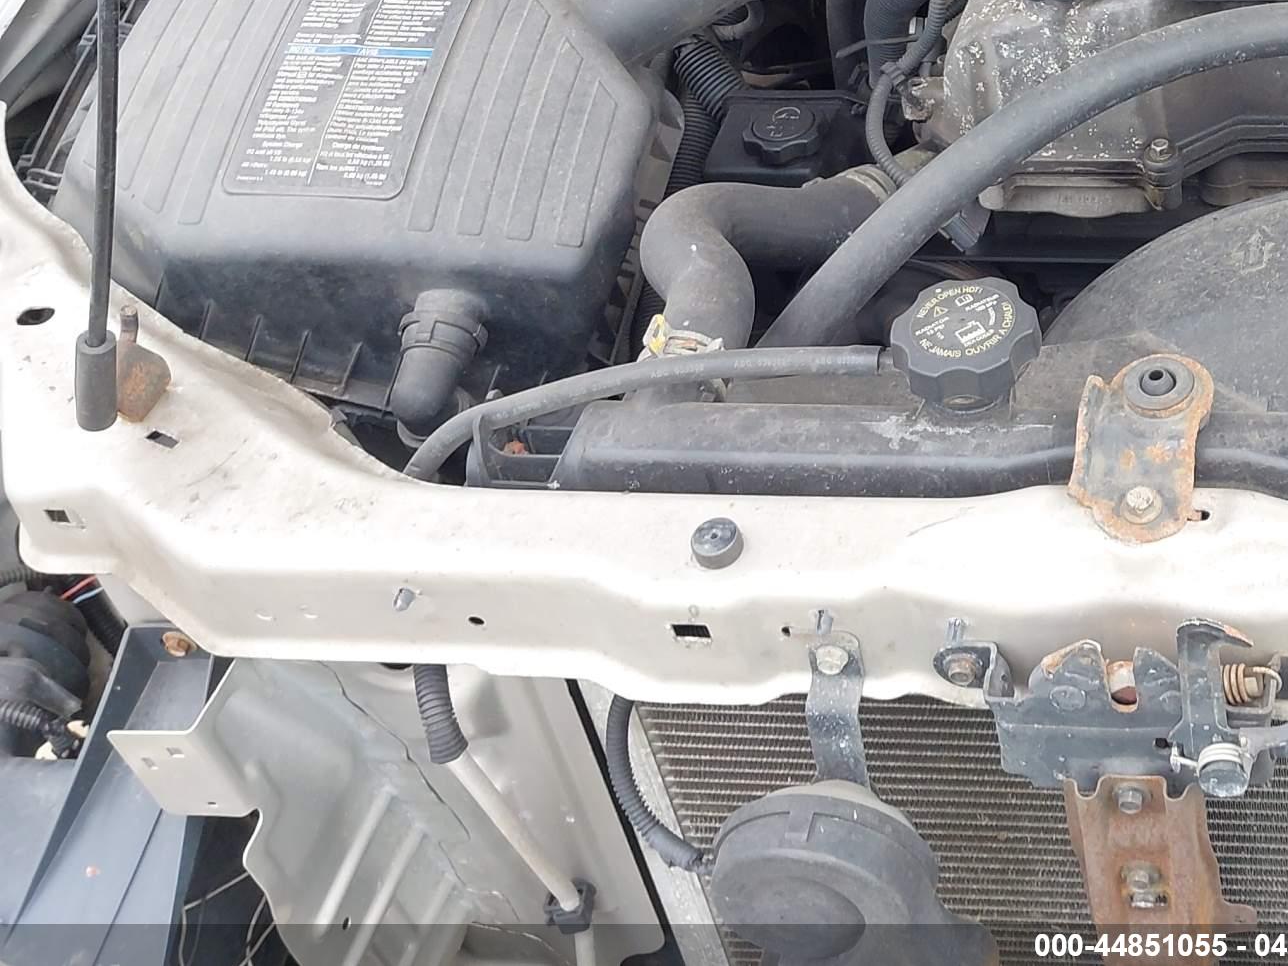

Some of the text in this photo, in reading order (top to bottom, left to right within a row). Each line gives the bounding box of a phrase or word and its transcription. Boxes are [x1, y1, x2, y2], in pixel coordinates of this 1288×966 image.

[916, 298, 939, 318] NEVER
[938, 288, 961, 300] OPEN
[919, 338, 934, 349] NE
[929, 345, 961, 358] JAMAIS
[965, 334, 1003, 356] OUVRIR
